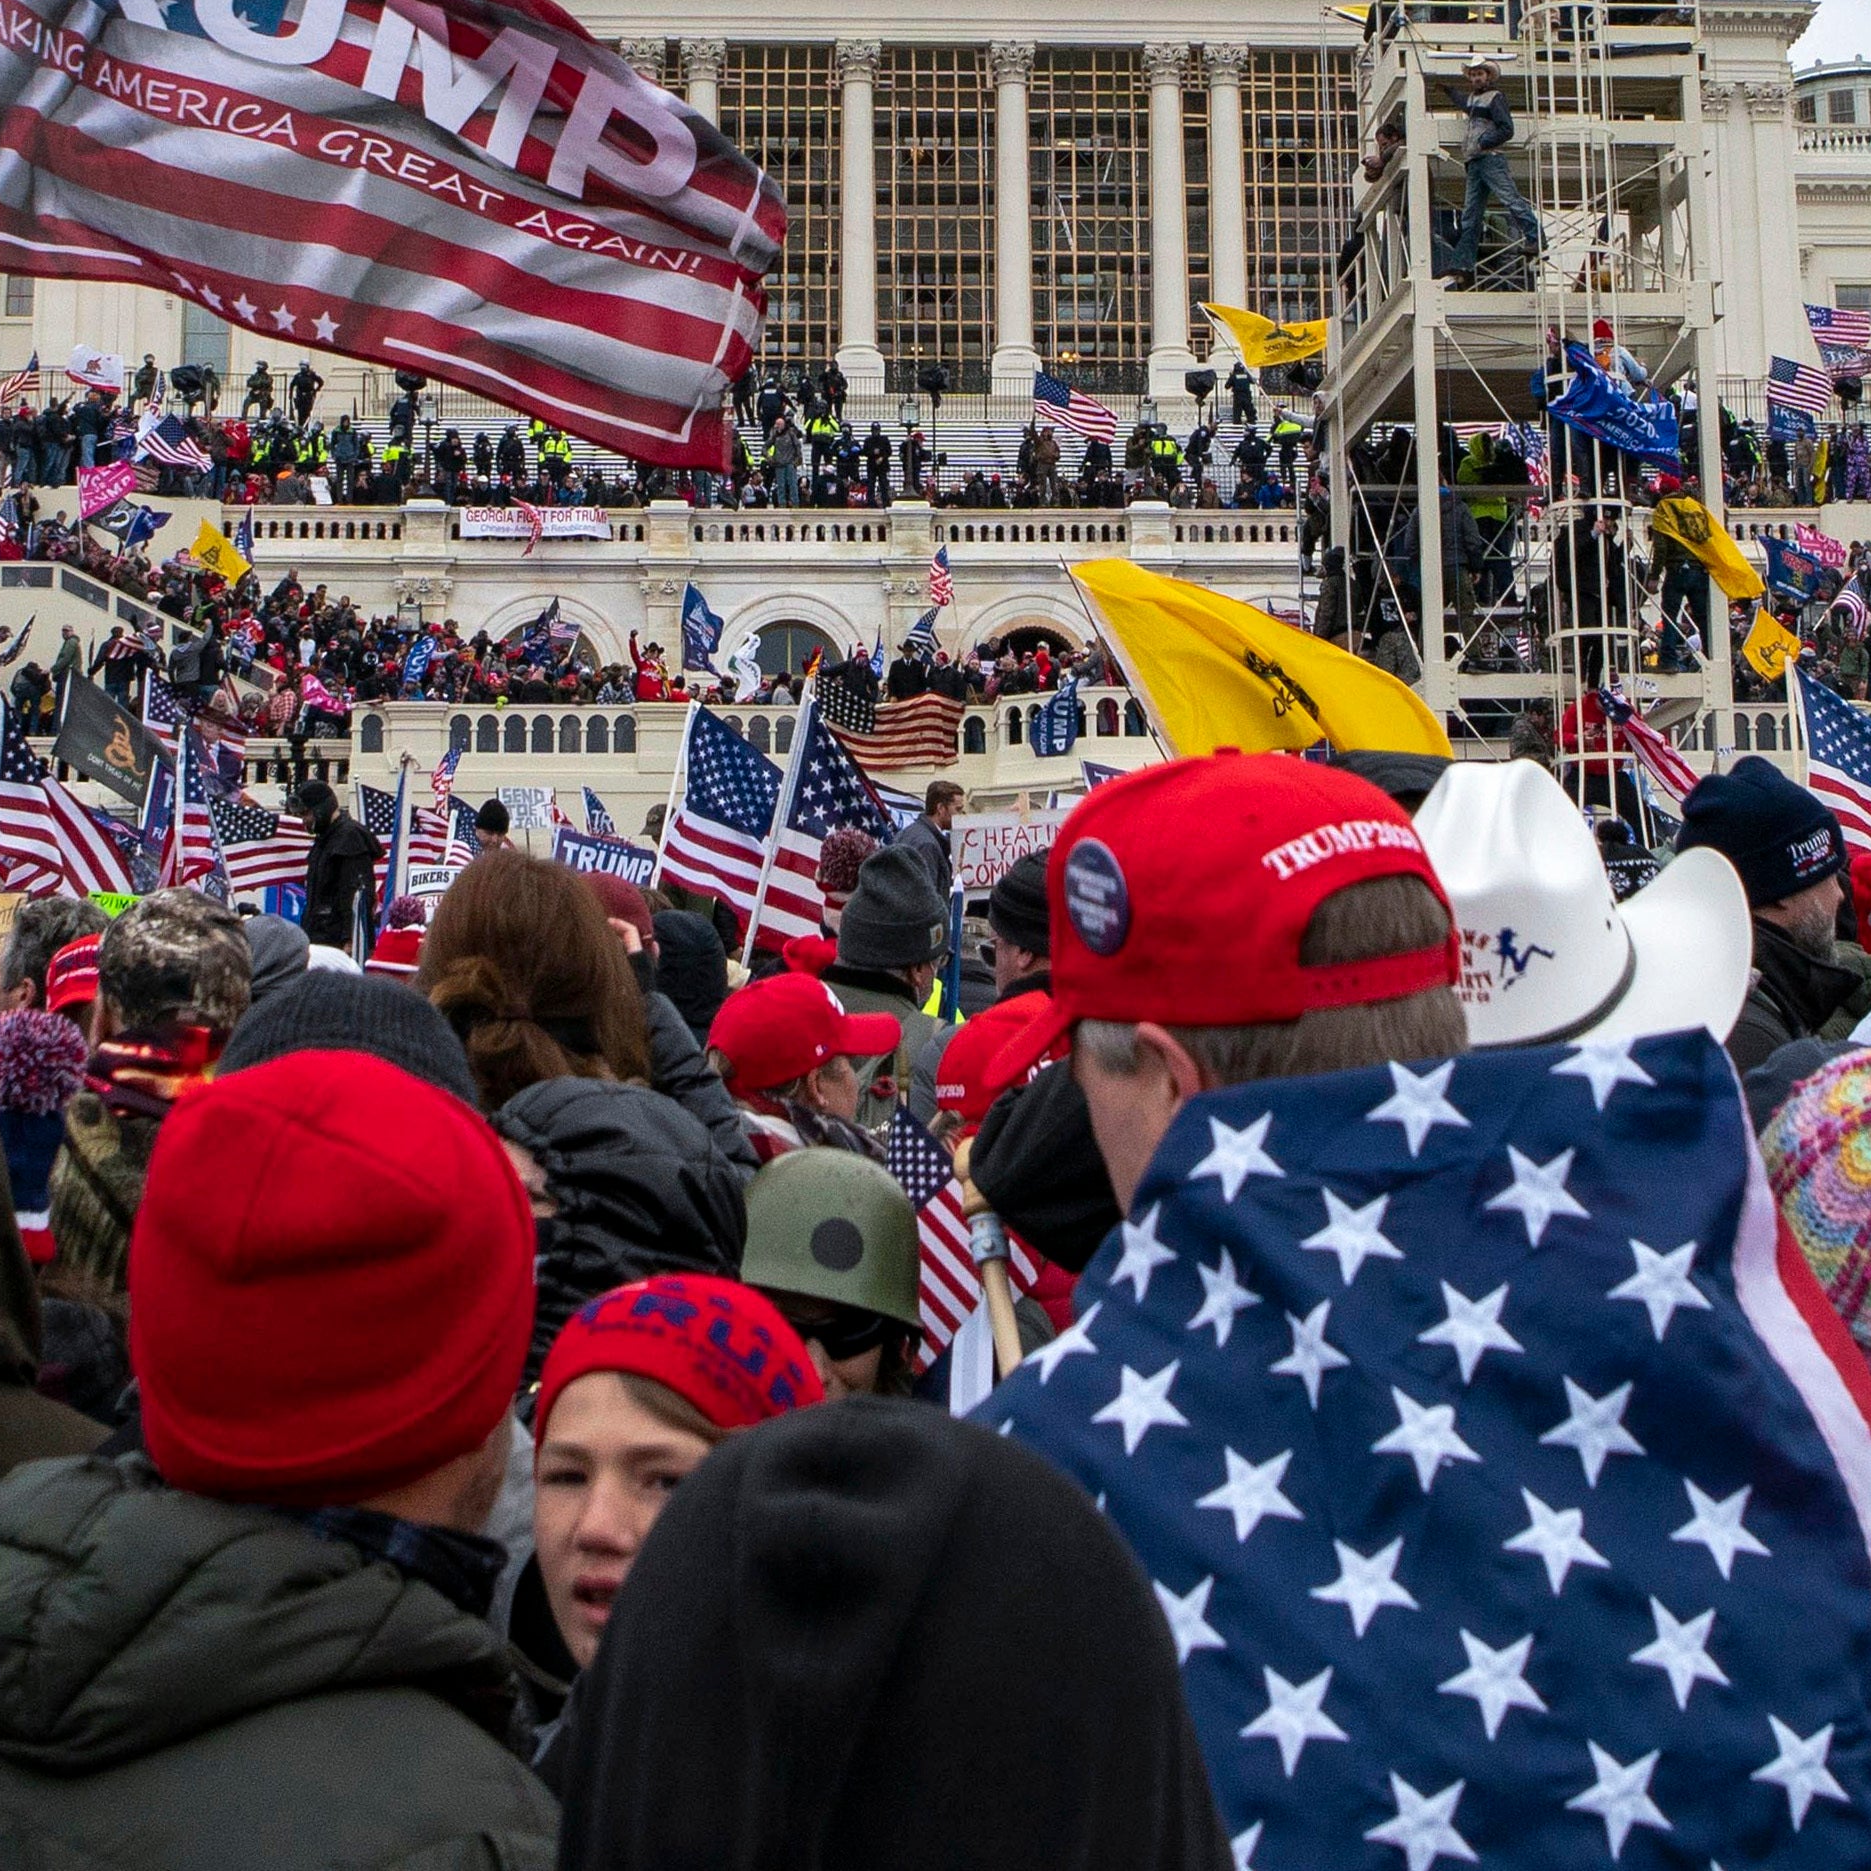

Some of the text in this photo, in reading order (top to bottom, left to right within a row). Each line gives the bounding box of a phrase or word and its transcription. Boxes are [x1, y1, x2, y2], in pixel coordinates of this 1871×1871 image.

[95, 57, 298, 158] AMERICA
[318, 128, 501, 212] GREAT
[516, 209, 702, 273] AGAIN!
[466, 510, 514, 523] GEORGIA
[551, 510, 573, 523] FOR
[502, 787, 545, 804] SEND
[515, 817, 548, 829] JAIL
[1786, 827, 1832, 859] Trump
[562, 840, 654, 885] TRUMP
[411, 871, 450, 888] BIKERS
[420, 894, 444, 908] TRU
